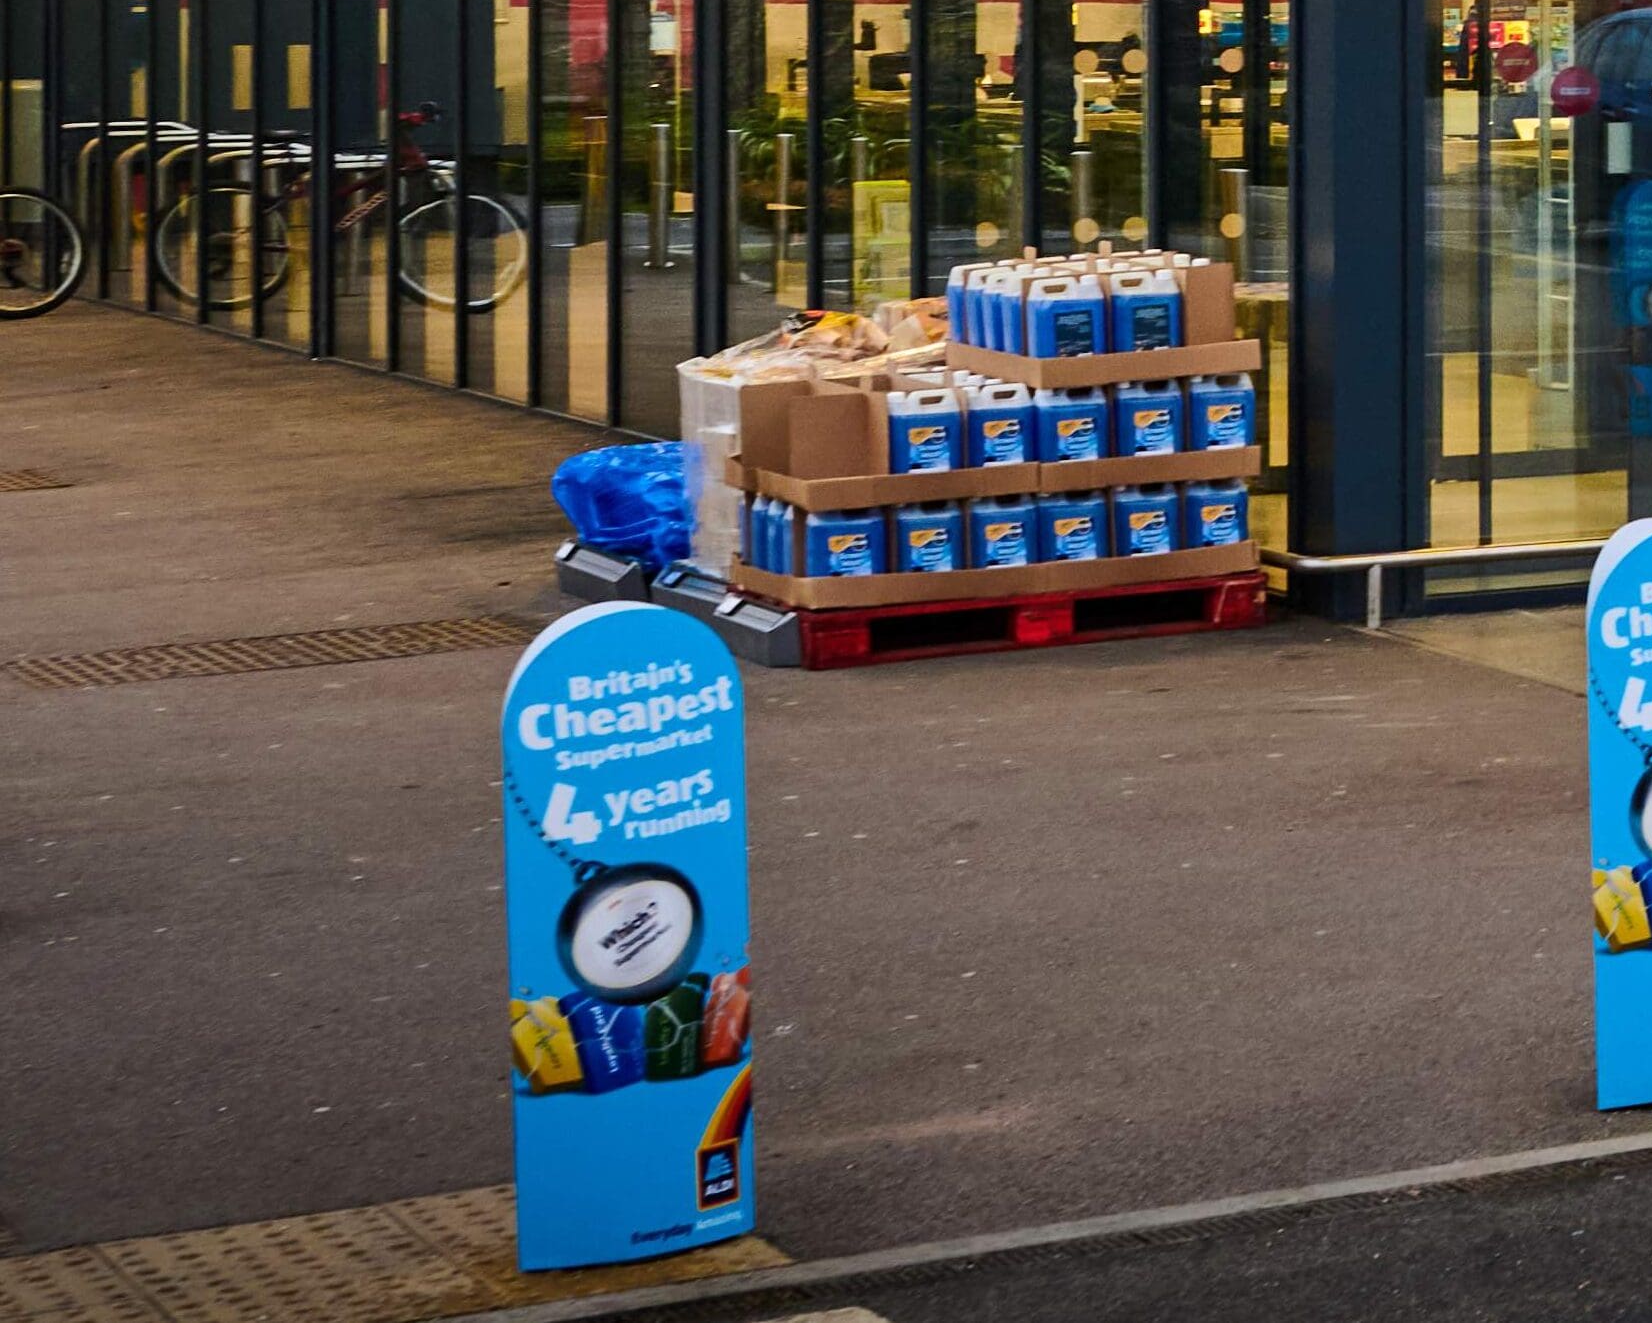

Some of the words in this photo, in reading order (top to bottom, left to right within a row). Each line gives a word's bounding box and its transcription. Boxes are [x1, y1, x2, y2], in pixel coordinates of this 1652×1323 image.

[569, 660, 693, 701] Britain's
[518, 676, 733, 750] Cheapest
[556, 724, 713, 770] Supermarket
[541, 783, 602, 845] 4
[604, 769, 714, 826] years
[625, 799, 731, 840] running
